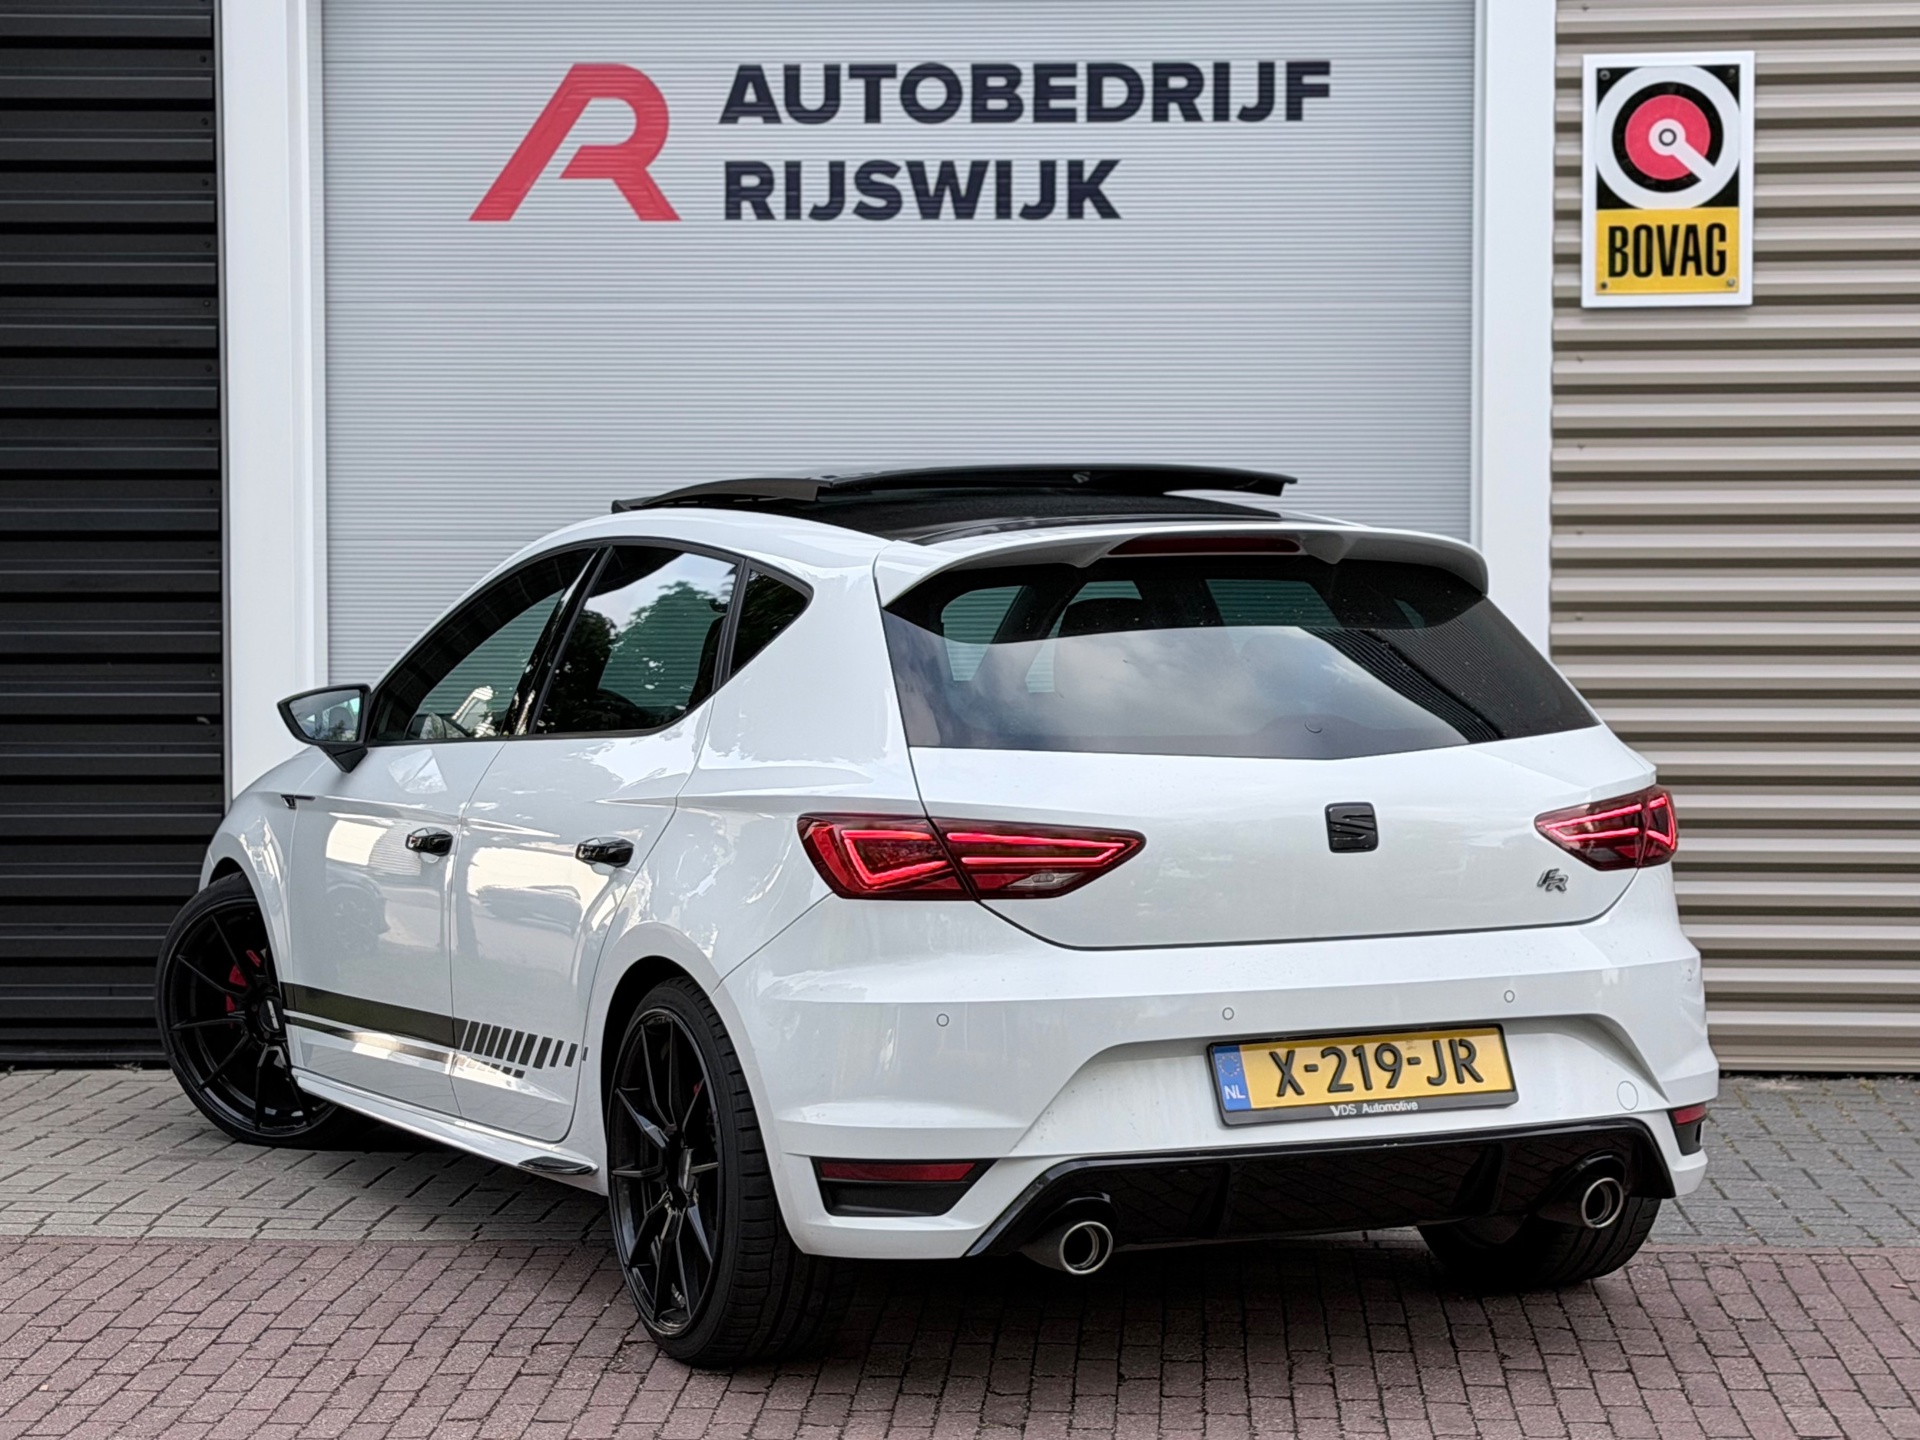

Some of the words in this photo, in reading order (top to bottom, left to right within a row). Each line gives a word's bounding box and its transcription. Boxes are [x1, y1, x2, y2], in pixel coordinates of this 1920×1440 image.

[719, 60, 1331, 125] AUTOBEDRIJF
[723, 159, 1122, 222] RIJSWIJK
[1608, 222, 1727, 278] BOVAG
[1224, 1084, 1246, 1100] NL
[1268, 1038, 1485, 1098] X-219-JR
[1330, 1105, 1357, 1117] VDS
[1362, 1101, 1419, 1114] Automotive
